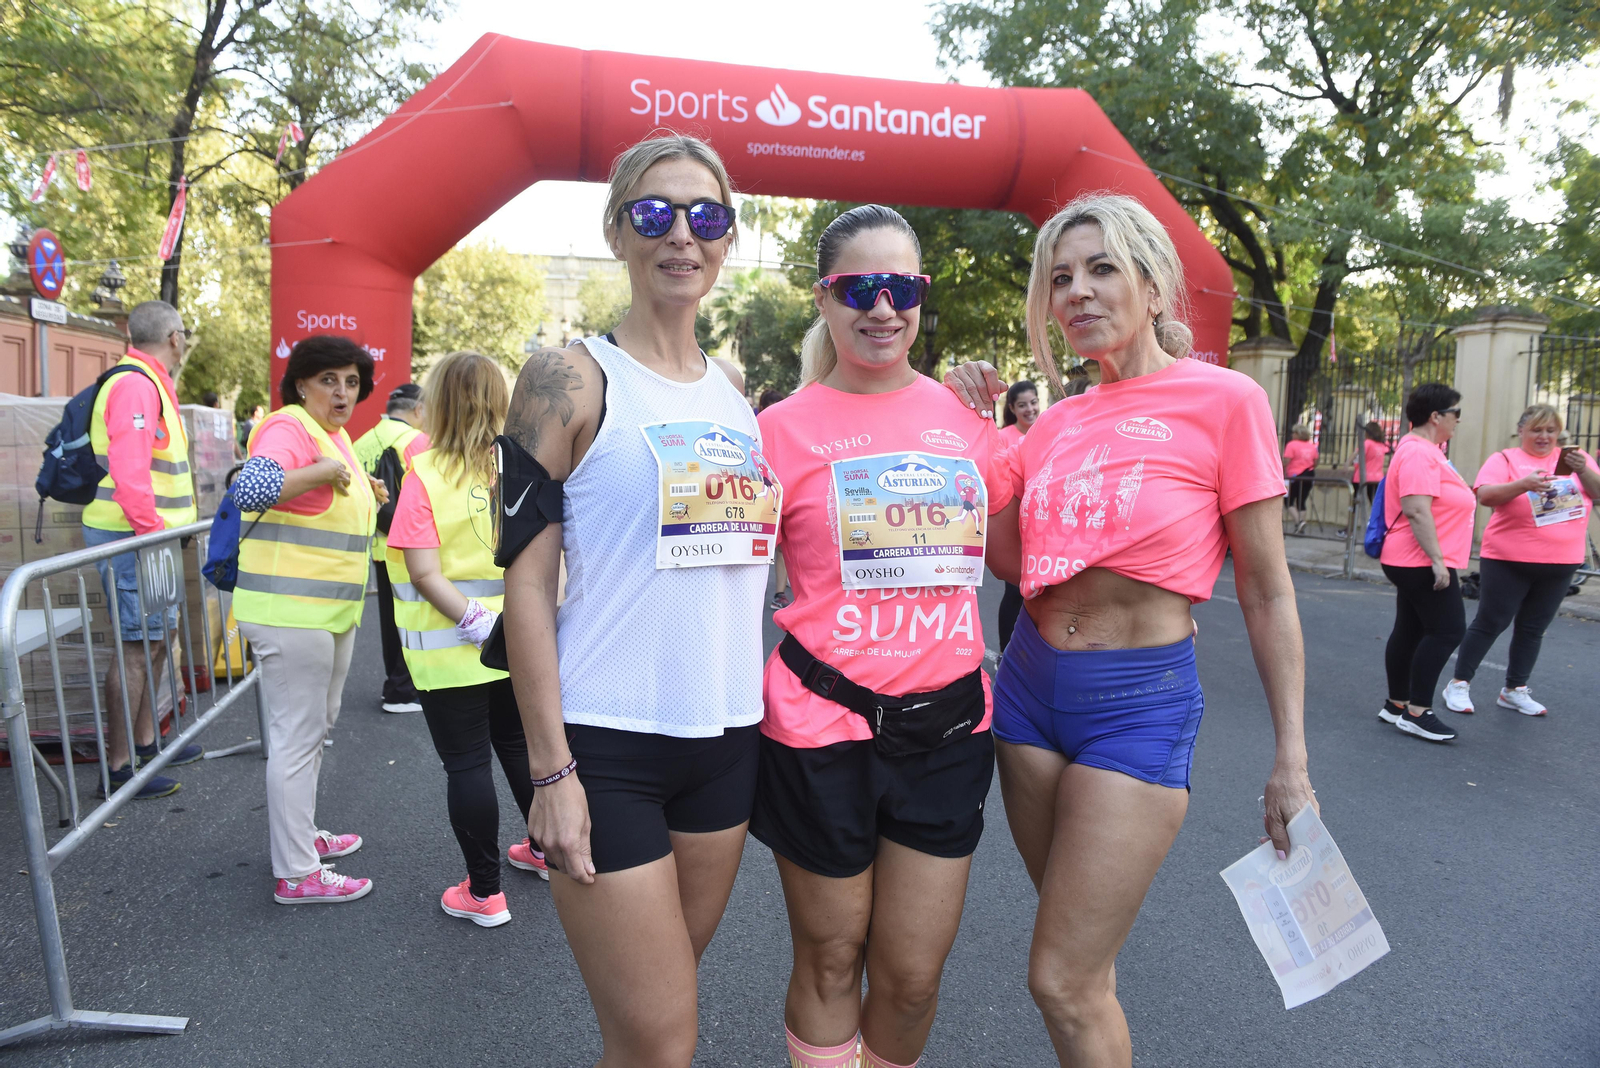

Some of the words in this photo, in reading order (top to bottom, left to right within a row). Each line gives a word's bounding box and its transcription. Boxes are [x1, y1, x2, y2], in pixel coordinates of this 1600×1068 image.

[630, 79, 749, 126] Sports
[807, 95, 987, 140] Santander
[746, 142, 866, 162] sportssantander.es
[296, 310, 357, 332] Sports
[1118, 422, 1167, 440] ASTURIANA
[810, 434, 871, 455] OYSHO
[925, 434, 965, 449] ASTURIANA
[700, 443, 745, 460] ASTURIANA
[706, 474, 754, 500] 016
[883, 474, 943, 487] ASTURIANA
[726, 506, 745, 519] 678
[885, 502, 947, 527] 016
[690, 522, 729, 533] CARRERA
[912, 533, 927, 544] 11
[671, 543, 722, 557] OYSHO
[873, 548, 911, 558] CARRERA
[938, 547, 963, 555] MUJER
[147, 547, 177, 603] IMD
[855, 567, 904, 579] OYSHO
[946, 565, 975, 574] Santander
[832, 601, 974, 643] SUMA
[546, 774, 560, 784] ABAD
